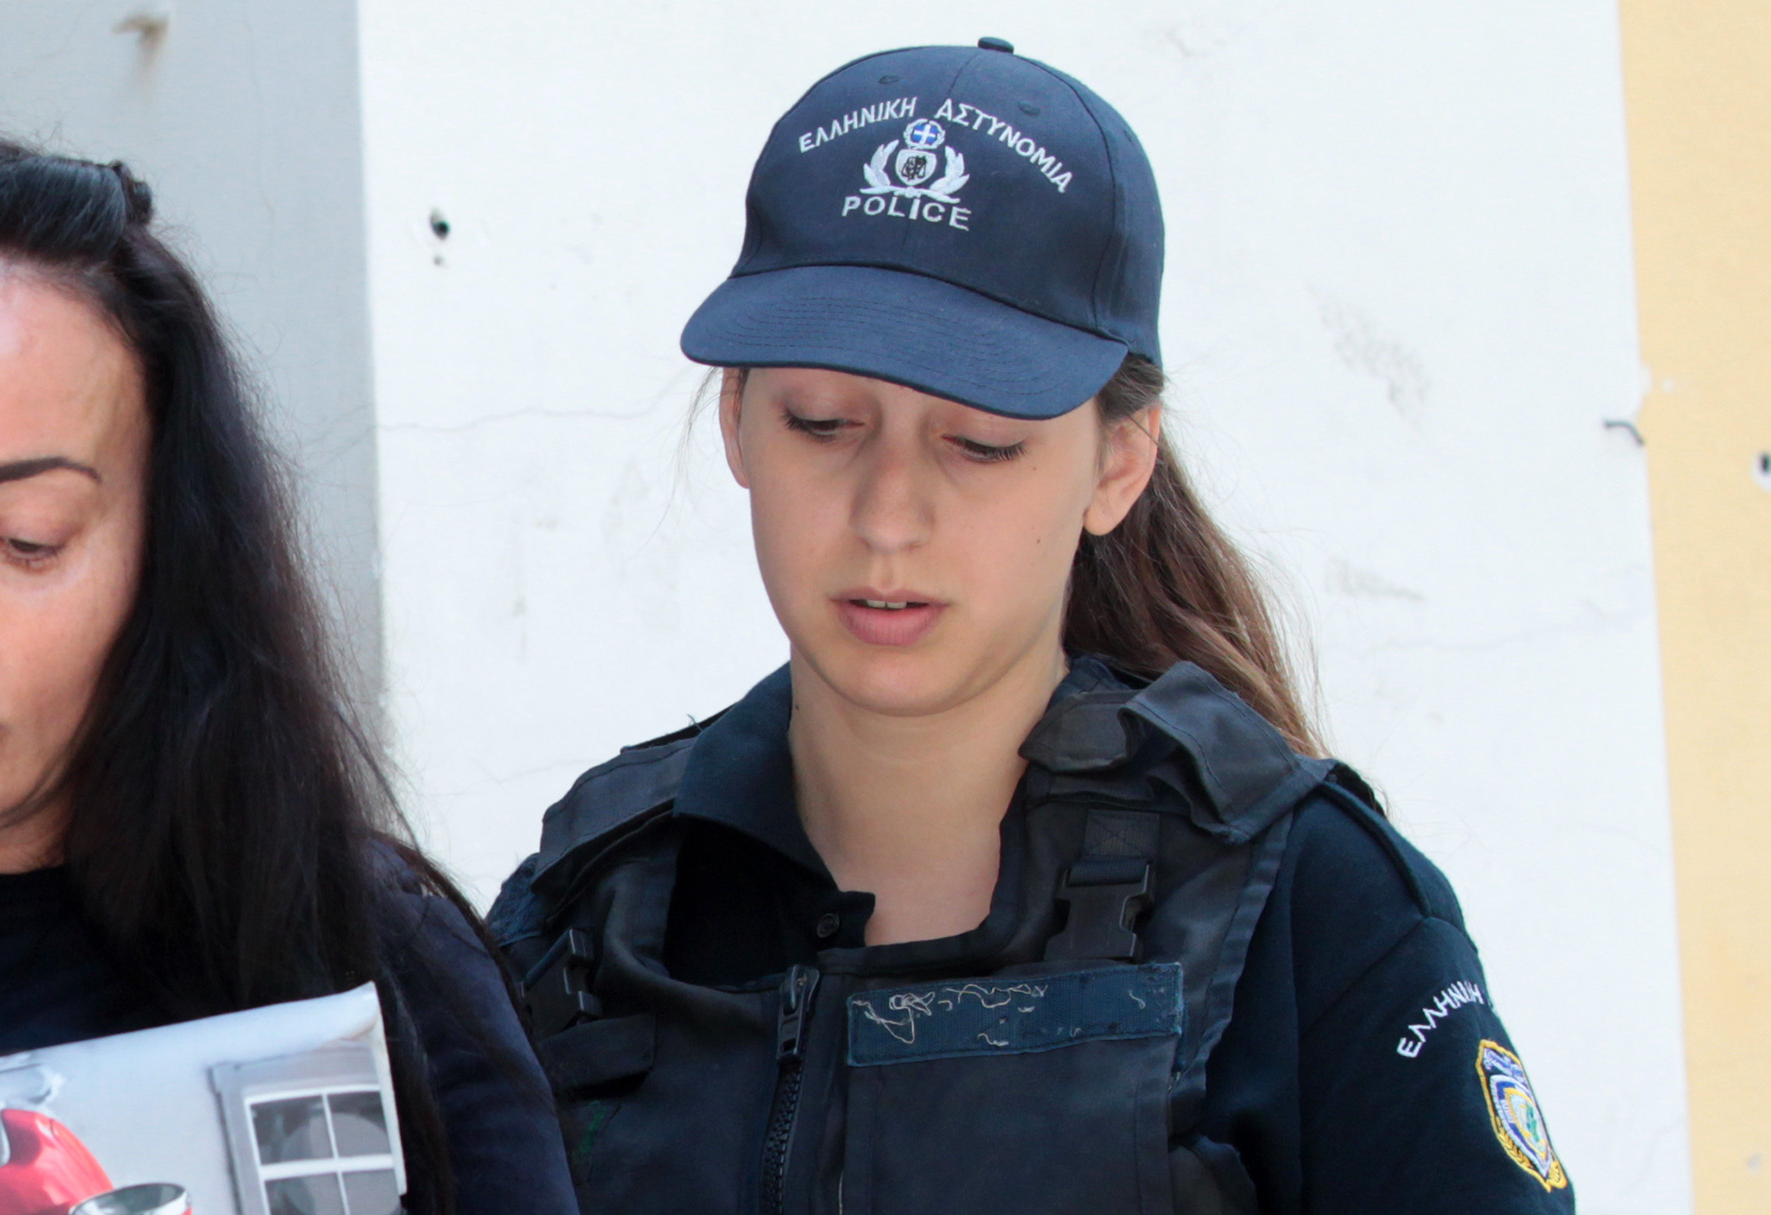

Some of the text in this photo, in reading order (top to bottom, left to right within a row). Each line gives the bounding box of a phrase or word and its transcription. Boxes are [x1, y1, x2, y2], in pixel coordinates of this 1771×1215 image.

[798, 97, 1073, 193] ΕΛΛΗΝΙΚΗ ΑΣΤΥΝΟΜΙΑ
[841, 196, 972, 231] POLICE
